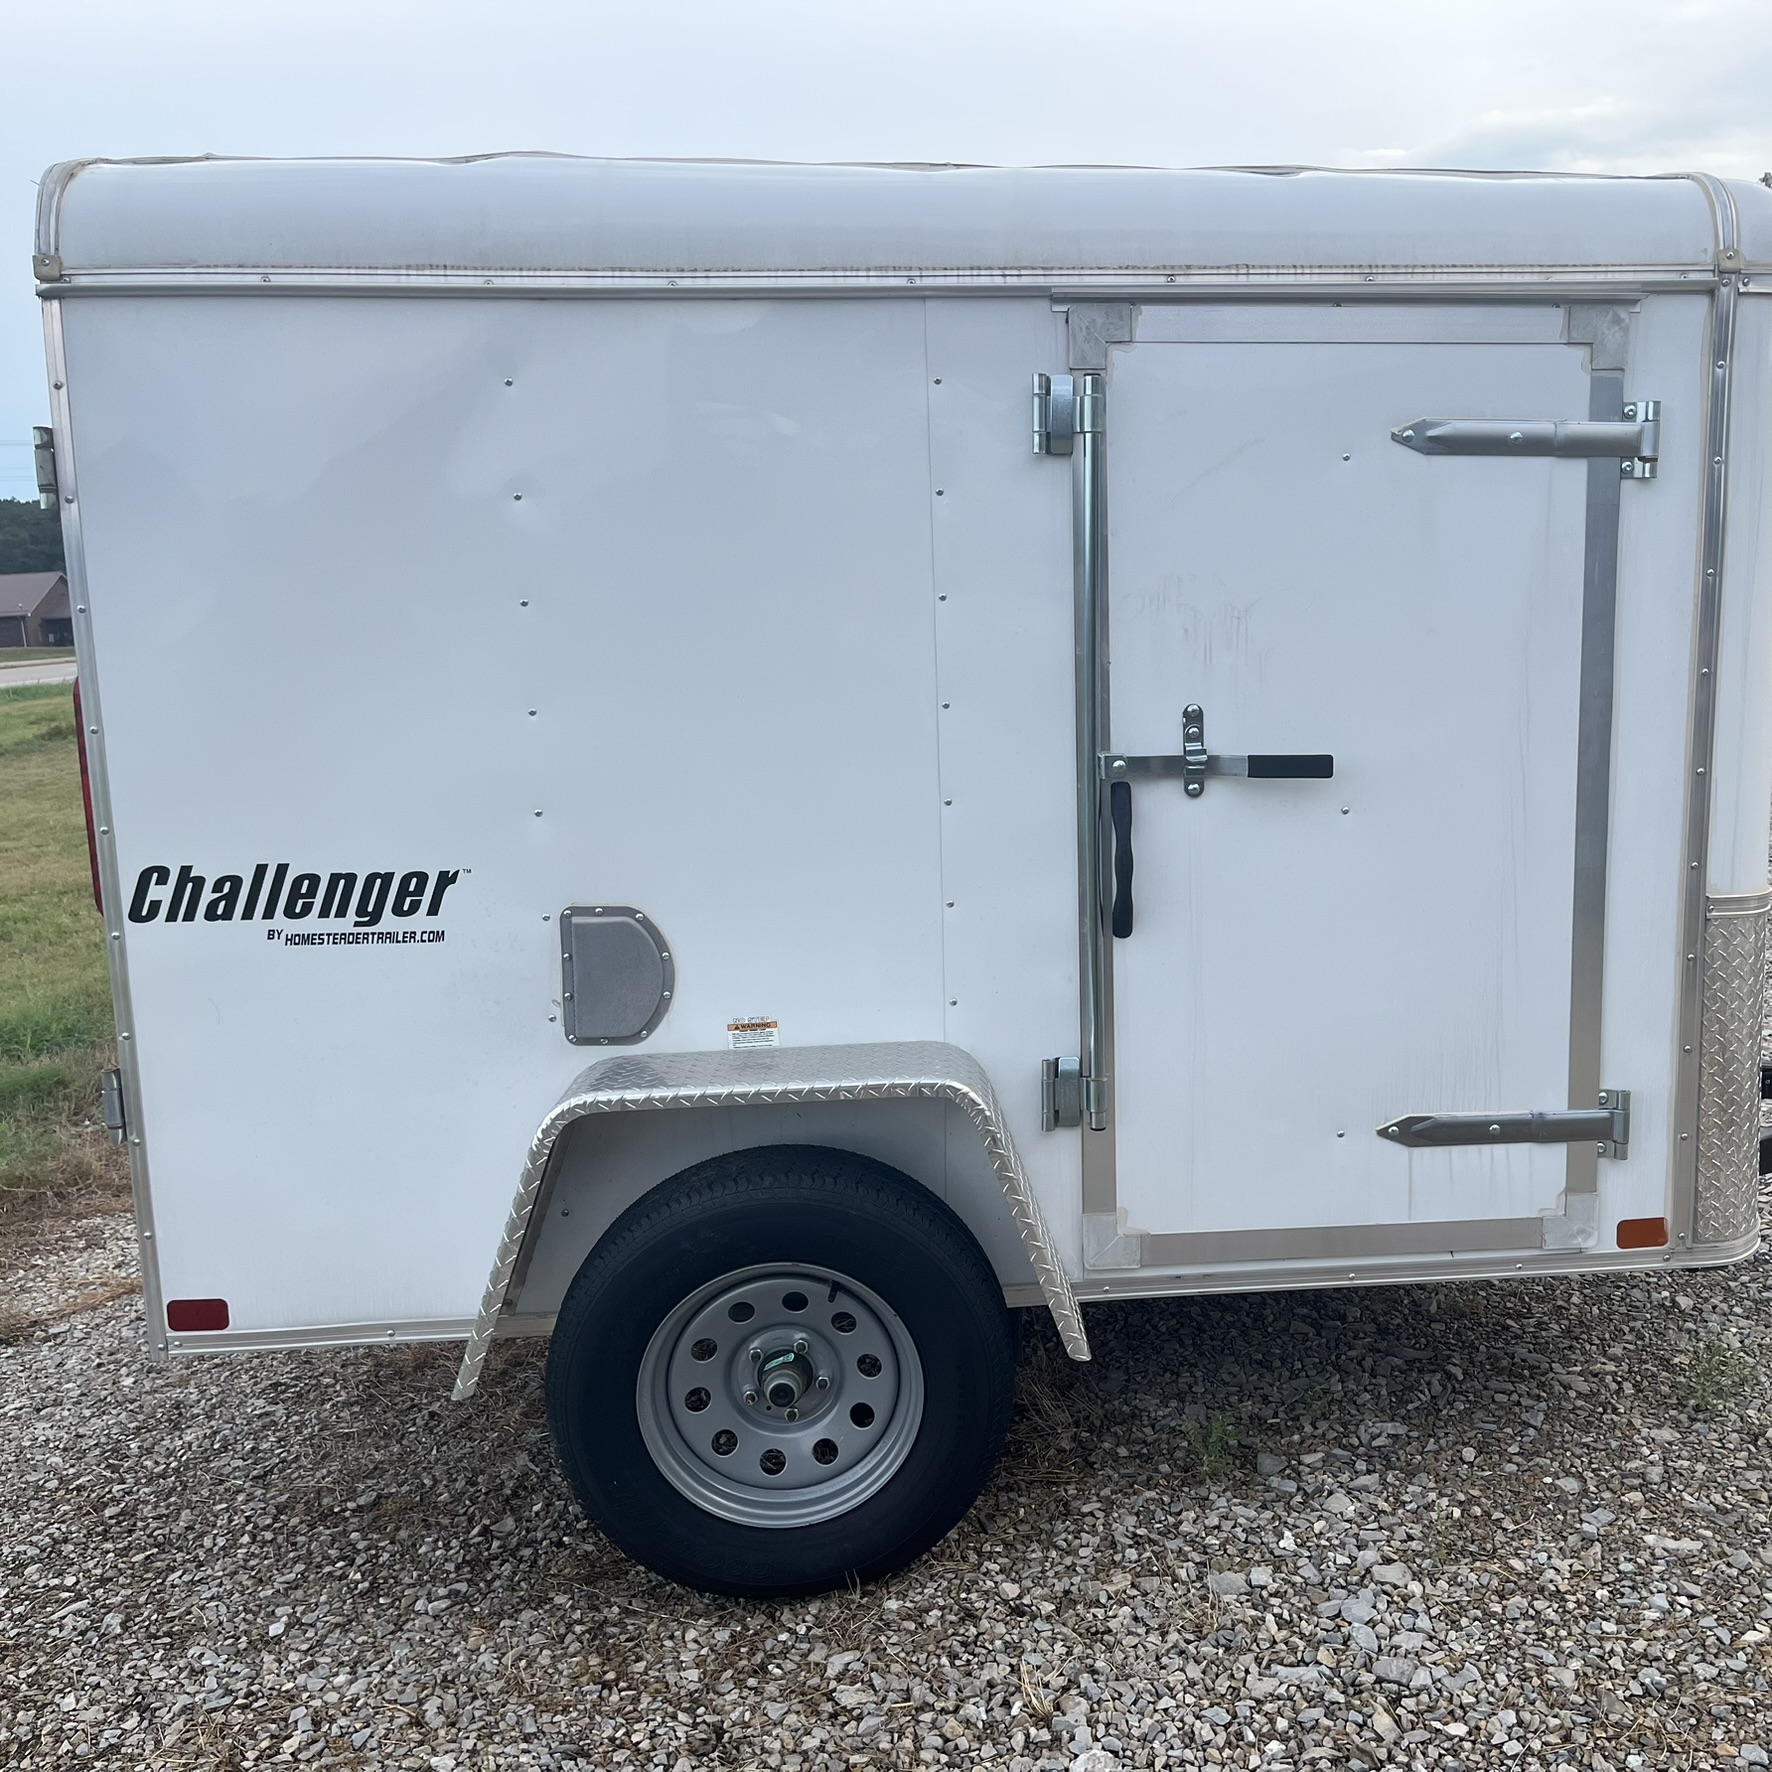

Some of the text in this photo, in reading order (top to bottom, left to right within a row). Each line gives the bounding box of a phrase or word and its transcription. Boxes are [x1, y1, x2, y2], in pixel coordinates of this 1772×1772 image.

[127, 862, 461, 928] Challenger
[267, 929, 446, 946] BY HOMESTEADERTRAILER.COM
